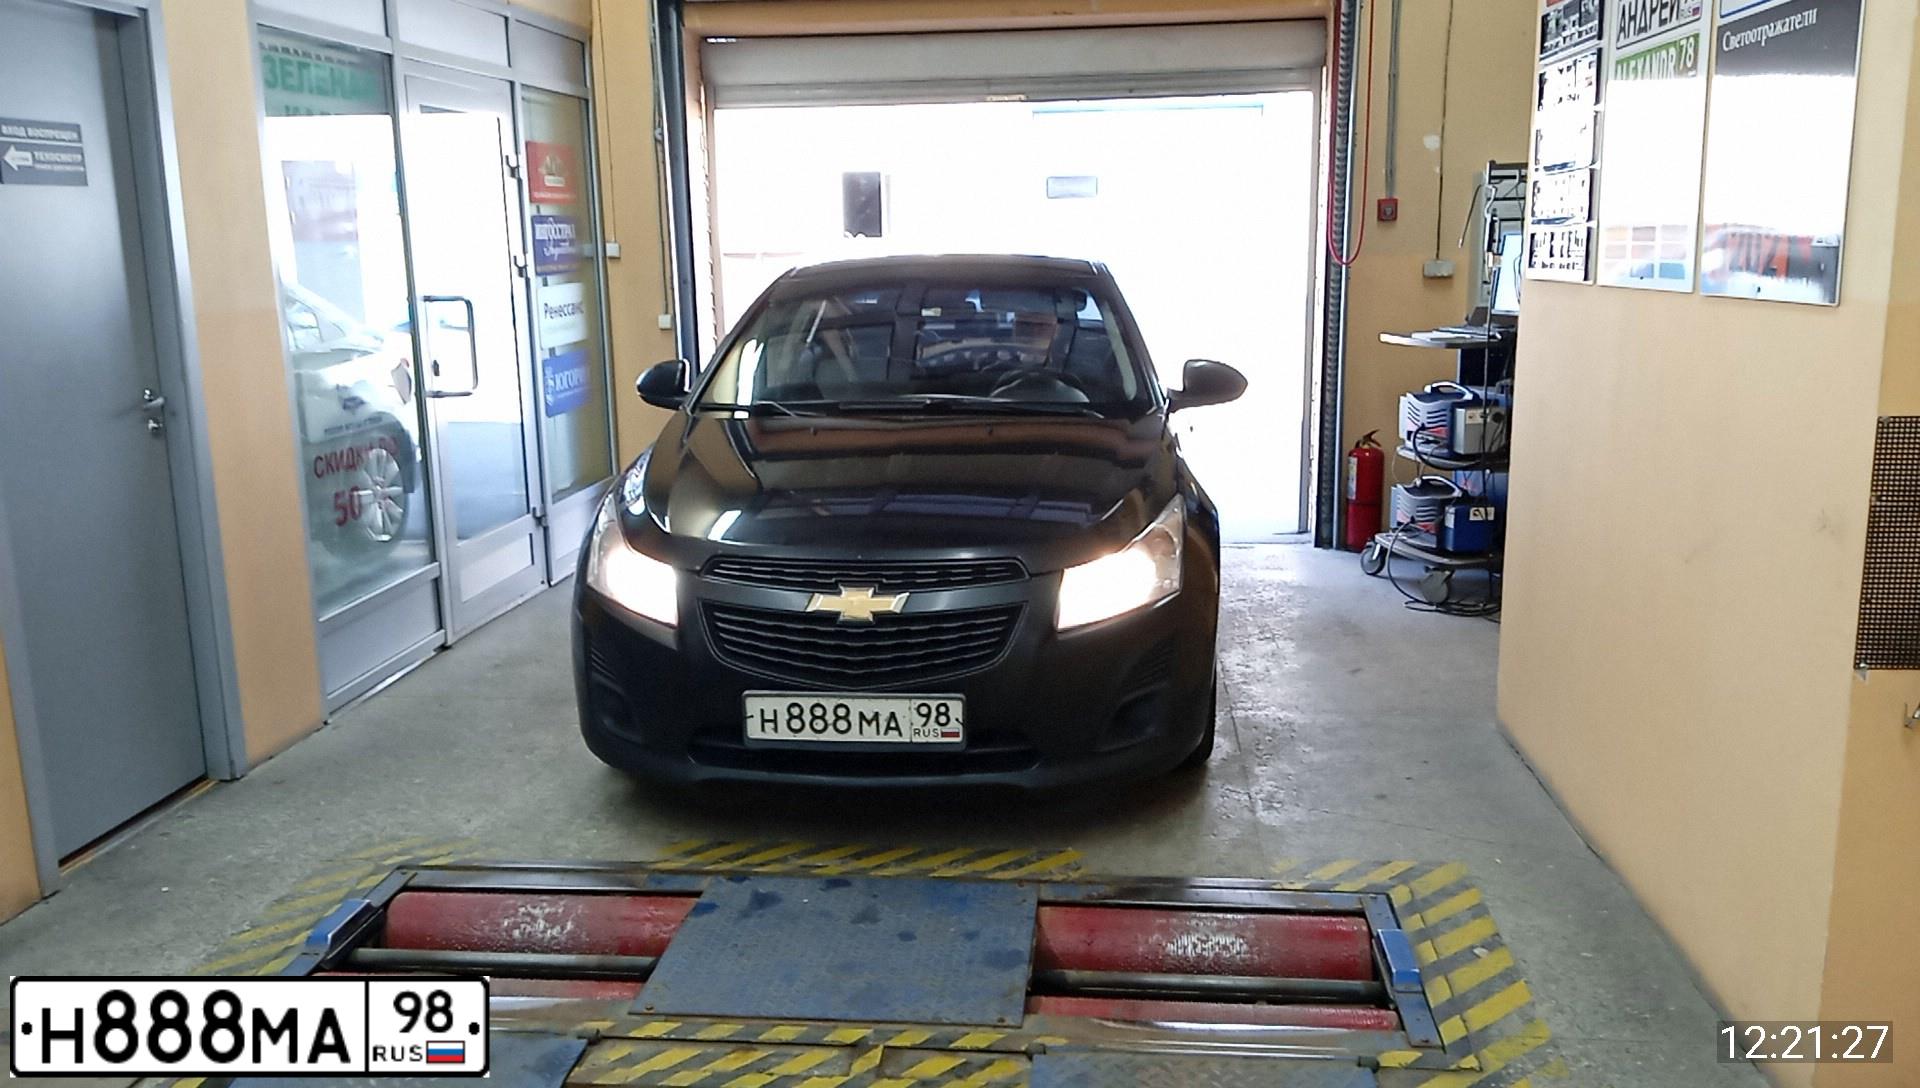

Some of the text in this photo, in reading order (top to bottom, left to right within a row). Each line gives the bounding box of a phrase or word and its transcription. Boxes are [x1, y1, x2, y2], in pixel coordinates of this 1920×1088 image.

[1722, 8, 1818, 52] Светоотражатели
[1679, 37, 1695, 70] 78
[262, 52, 376, 102] ЗЕЛЕН
[760, 702, 950, 738] Н888МА 98
[914, 728, 939, 738] RUS
